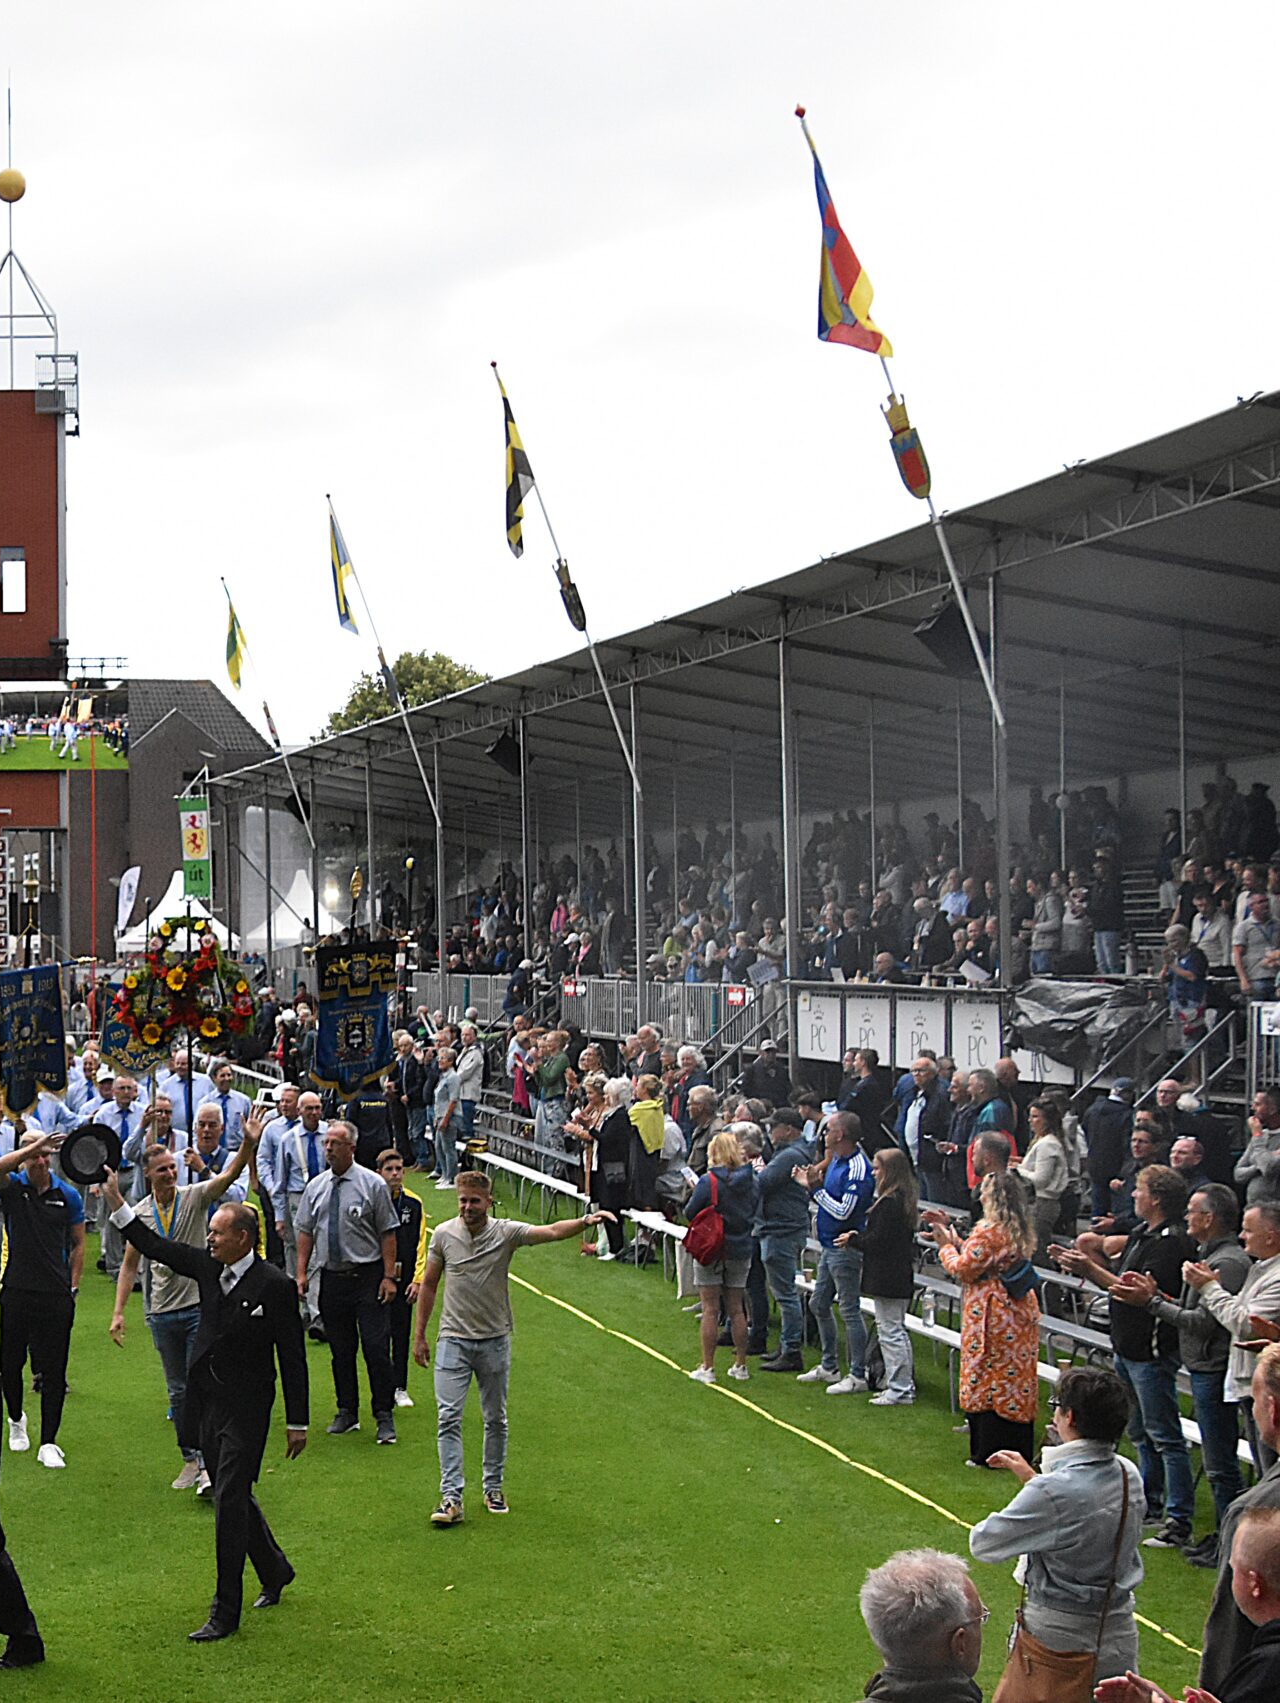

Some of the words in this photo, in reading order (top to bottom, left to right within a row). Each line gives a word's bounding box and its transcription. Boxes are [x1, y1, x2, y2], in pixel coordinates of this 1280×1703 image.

[189, 864, 204, 881] út
[811, 1023, 827, 1053] PC
[968, 1035, 988, 1067] PC
